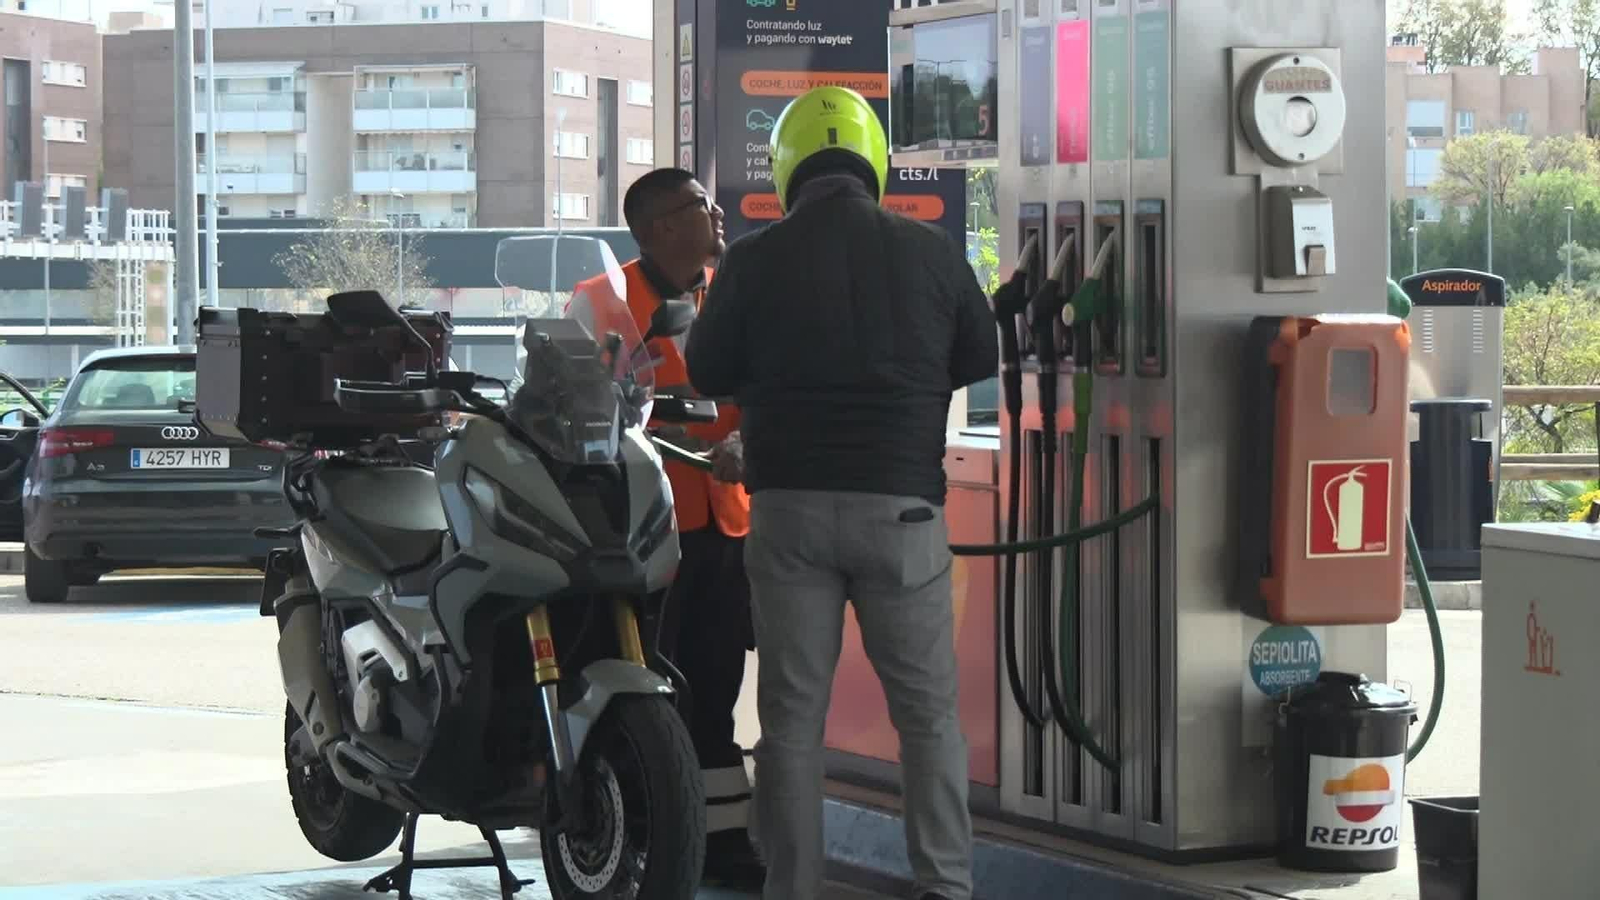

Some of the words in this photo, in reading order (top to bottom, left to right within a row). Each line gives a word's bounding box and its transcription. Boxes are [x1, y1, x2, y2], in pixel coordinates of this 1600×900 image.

[746, 19, 806, 31] Contratando
[807, 20, 822, 31] luz
[746, 34, 753, 45] y
[754, 33, 796, 46] pagando
[798, 36, 816, 44] con
[818, 35, 852, 46] waylet
[787, 79, 806, 90] LUZ
[807, 79, 814, 90] Y
[978, 105, 988, 136] 5
[746, 142, 770, 153] Cont
[746, 157, 753, 168] y
[746, 170, 753, 181] y
[899, 166, 939, 181] cts./l
[1422, 280, 1481, 293] Aspirador
[146, 450, 186, 466] 4257
[191, 450, 222, 466] HYR
[1253, 641, 1316, 665] SEPIOLITA
[1259, 669, 1311, 686] ABSORBENTE
[1310, 825, 1397, 845] REPSOL
